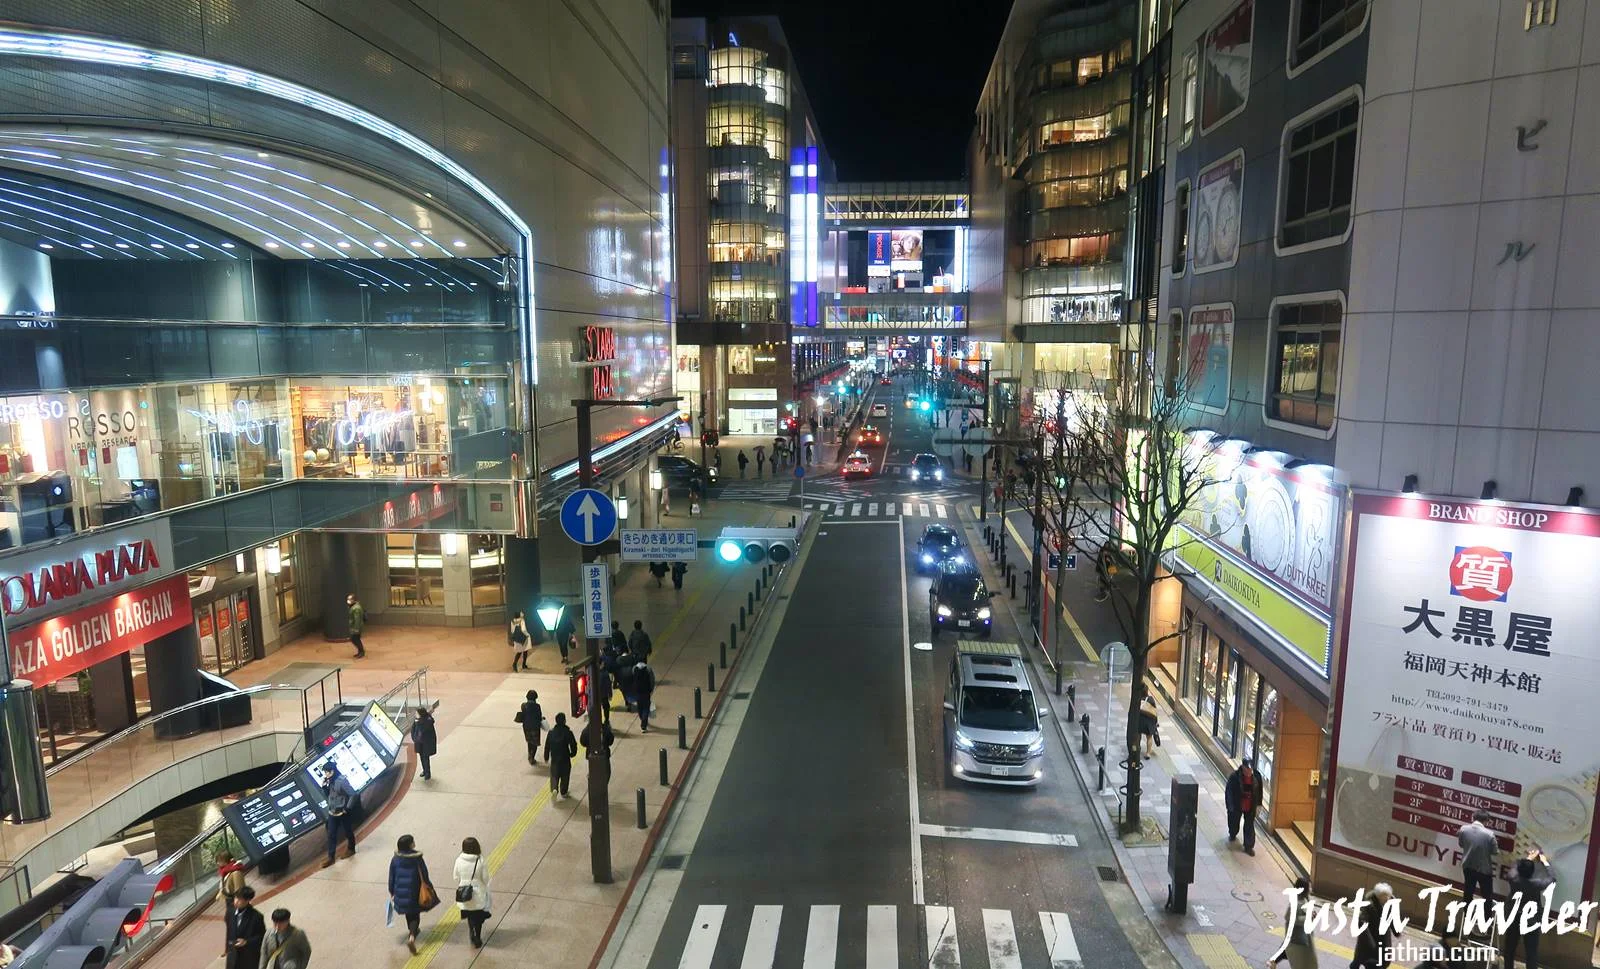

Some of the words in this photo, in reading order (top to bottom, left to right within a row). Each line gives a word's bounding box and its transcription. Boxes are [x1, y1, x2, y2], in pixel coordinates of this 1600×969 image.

[593, 365, 614, 400] PLAZA
[68, 411, 136, 439] ROSSO
[102, 436, 138, 448] RESEARCH
[1429, 503, 1489, 522] BRAND
[1495, 507, 1548, 529] SHOP
[624, 533, 694, 545] きらめき通り東口
[95, 539, 160, 585] PLAZA
[1456, 553, 1508, 596] 質
[1223, 569, 1260, 608] DAIKOKUYA
[1287, 564, 1306, 586] DUTY
[1307, 576, 1326, 599] FREE
[590, 567, 604, 634] 歩車分離信号
[13, 637, 48, 678] AZA
[51, 612, 112, 662] GOLDEN
[114, 590, 174, 638] BARGAIN
[1402, 599, 1553, 658] 大黒屋
[1403, 651, 1542, 694] 福岡天神本館
[1372, 711, 1427, 734] ブランド品
[1391, 694, 1544, 734] http://www.daikokuya78.com
[1404, 758, 1448, 778] 質・買取
[1411, 781, 1425, 791] 5F
[1442, 789, 1517, 813] 質・買取コーナー
[1479, 776, 1506, 793] 販売
[1409, 798, 1423, 808] 2F
[1409, 813, 1422, 824] 1F
[1386, 832, 1449, 861] DUTY
